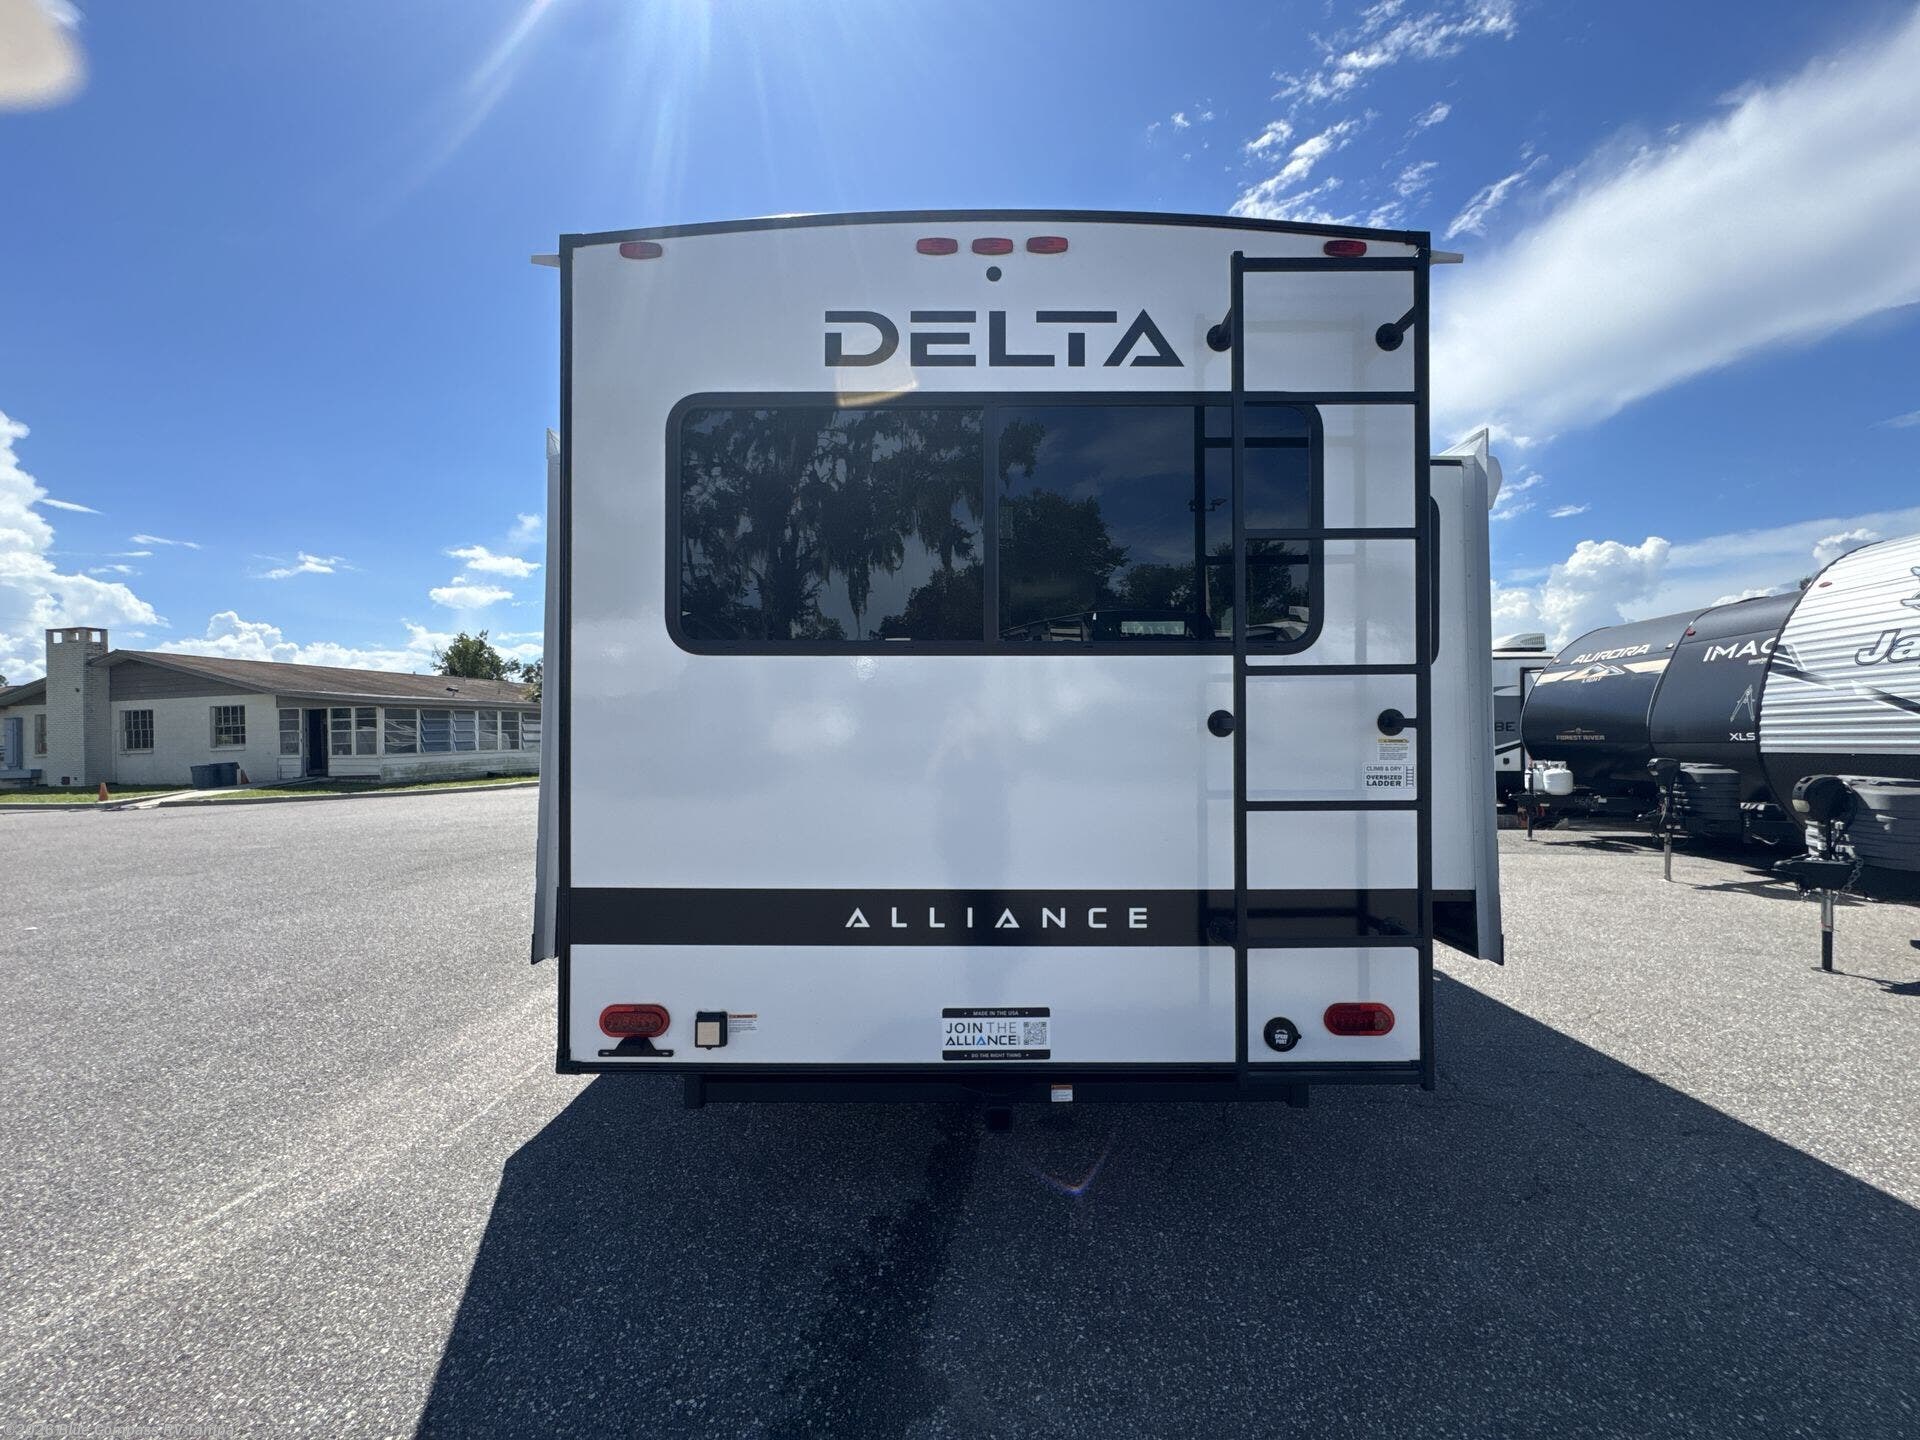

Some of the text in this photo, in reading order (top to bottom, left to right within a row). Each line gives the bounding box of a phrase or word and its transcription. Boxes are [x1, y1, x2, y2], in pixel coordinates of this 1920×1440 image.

[825, 308, 1185, 367] DELTA
[1570, 644, 1651, 665] AURORA
[1729, 732, 1756, 741] XLS
[845, 907, 1148, 929] ALLIANCE
[945, 1022, 1017, 1034] JOIN THE
